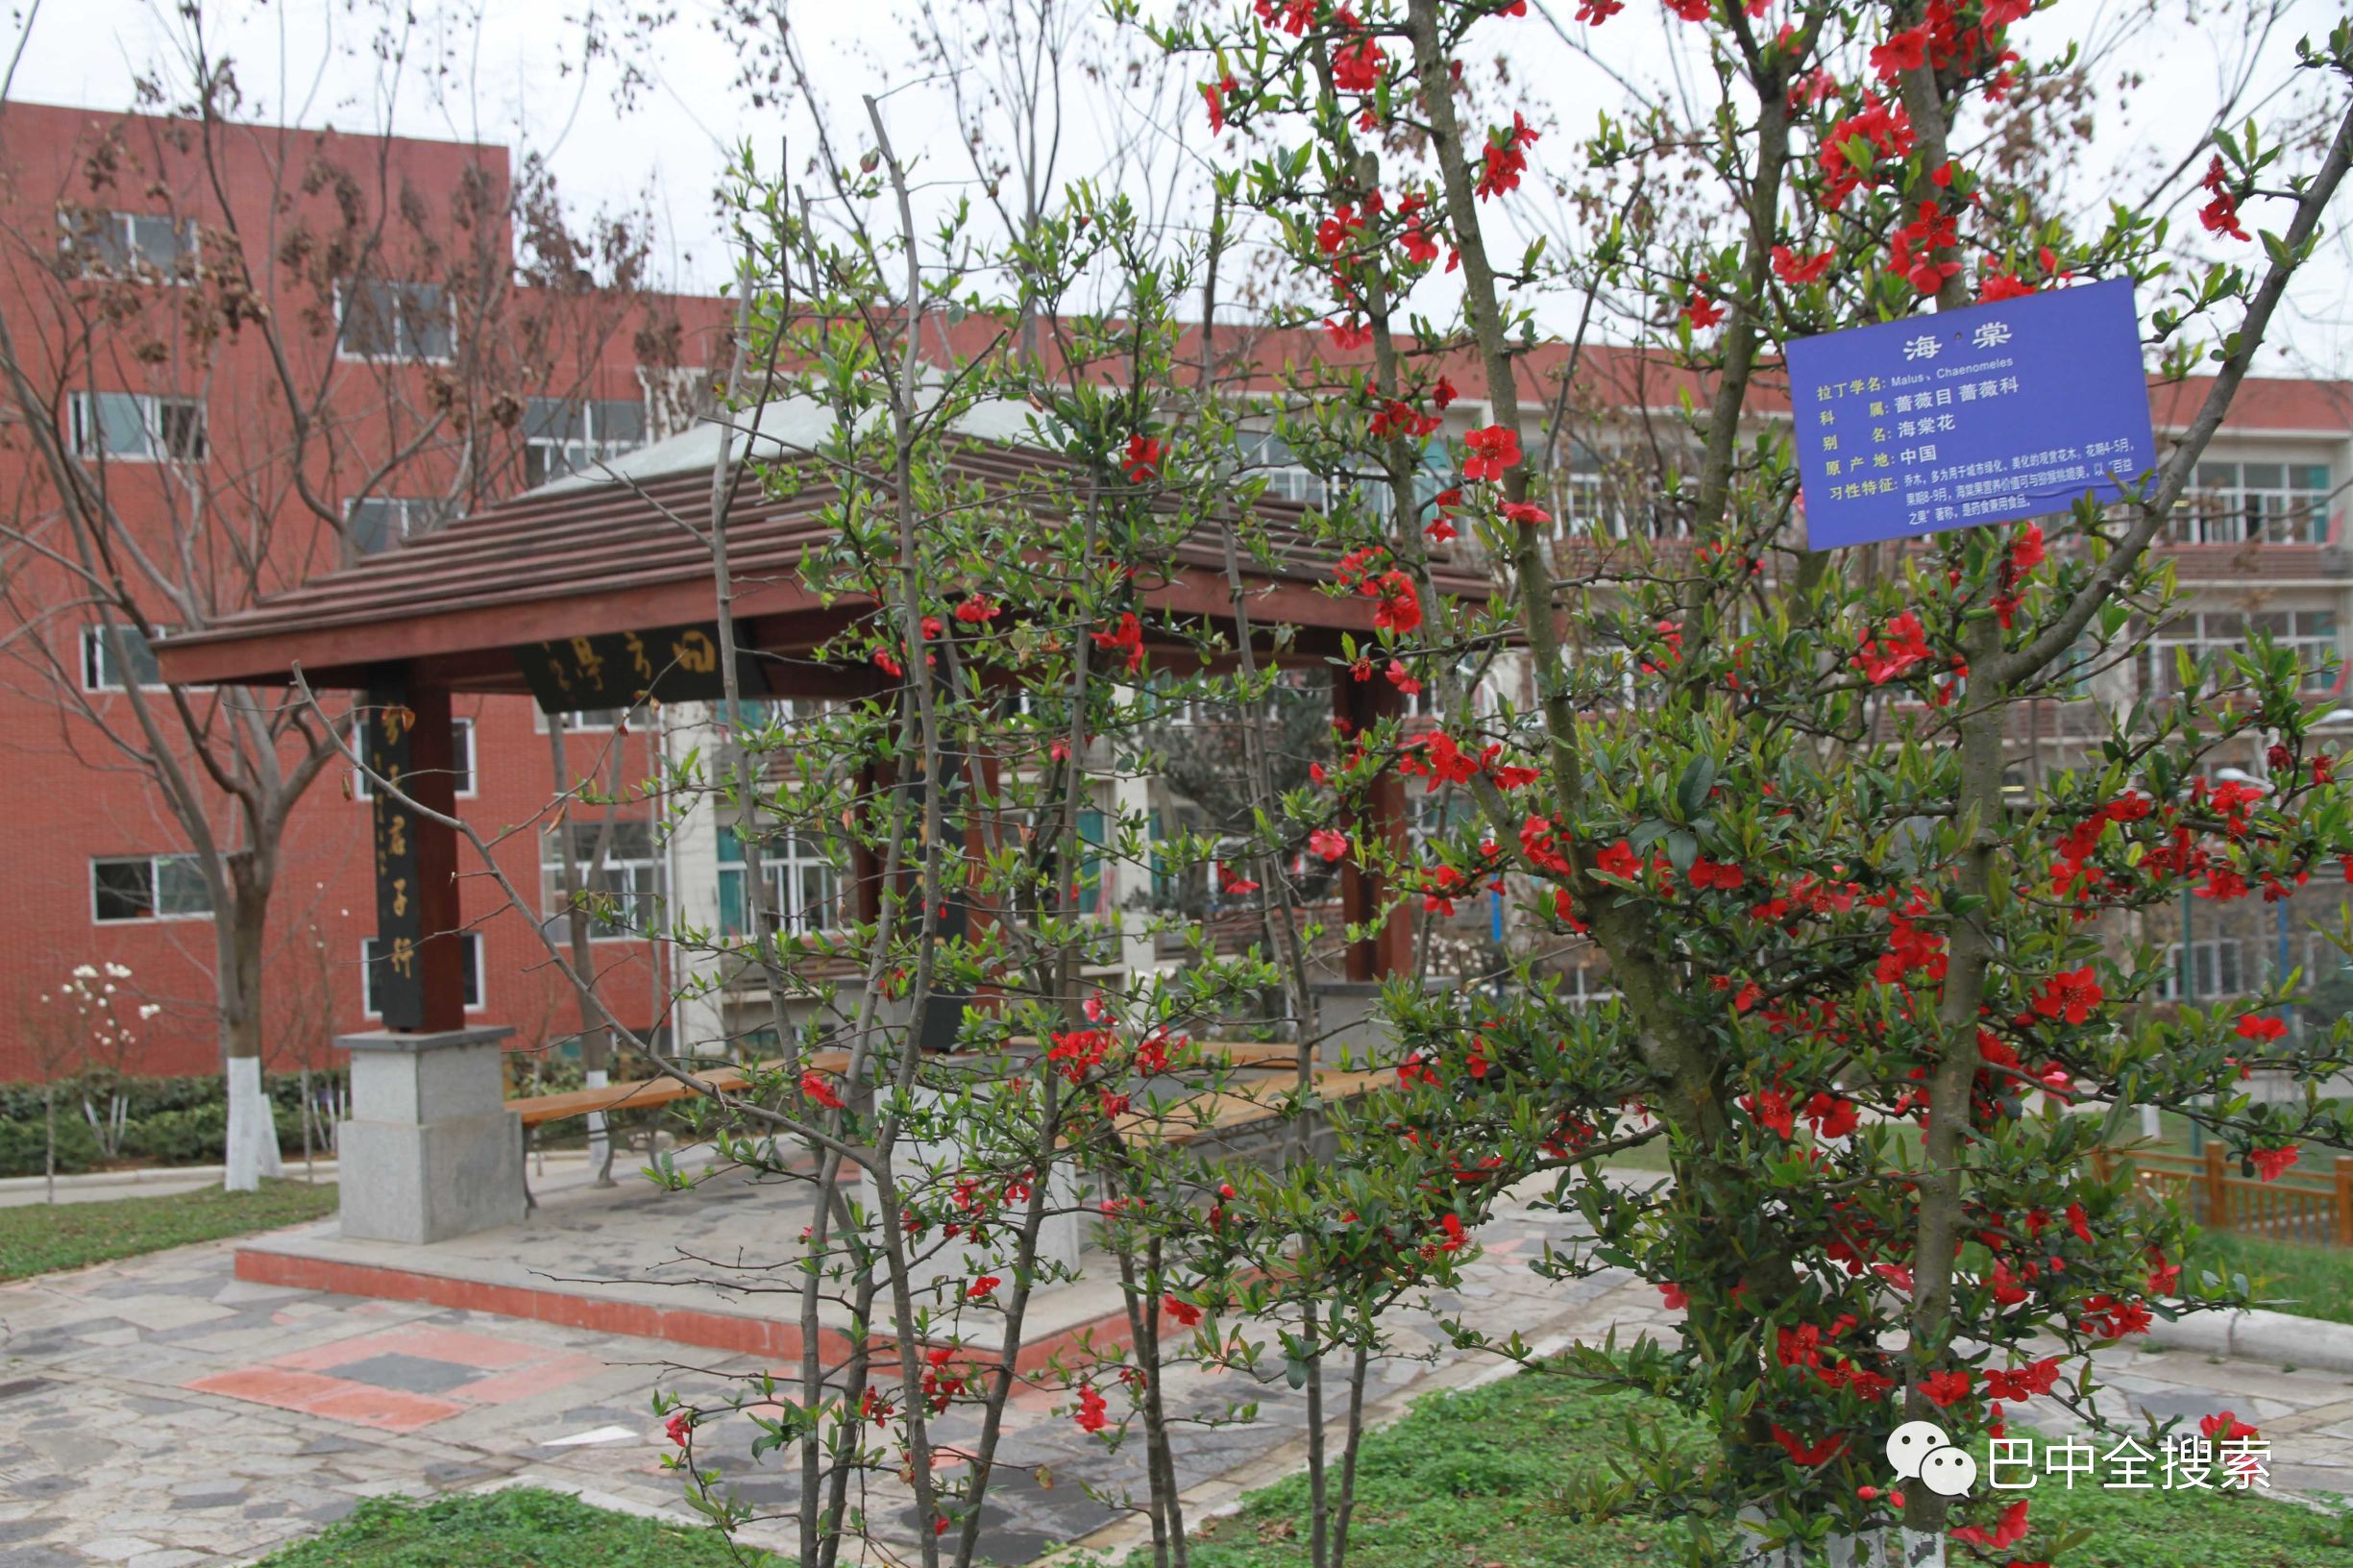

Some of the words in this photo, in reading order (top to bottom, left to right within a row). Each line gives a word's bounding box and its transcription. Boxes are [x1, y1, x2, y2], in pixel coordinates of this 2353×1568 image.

[1903, 322, 2013, 362] 海棠
[1894, 388, 1952, 413] 蔷薇目
[1958, 376, 2019, 403] 蔷薇科
[1898, 413, 1956, 438] 海棠花
[1900, 444, 1937, 466] 中国
